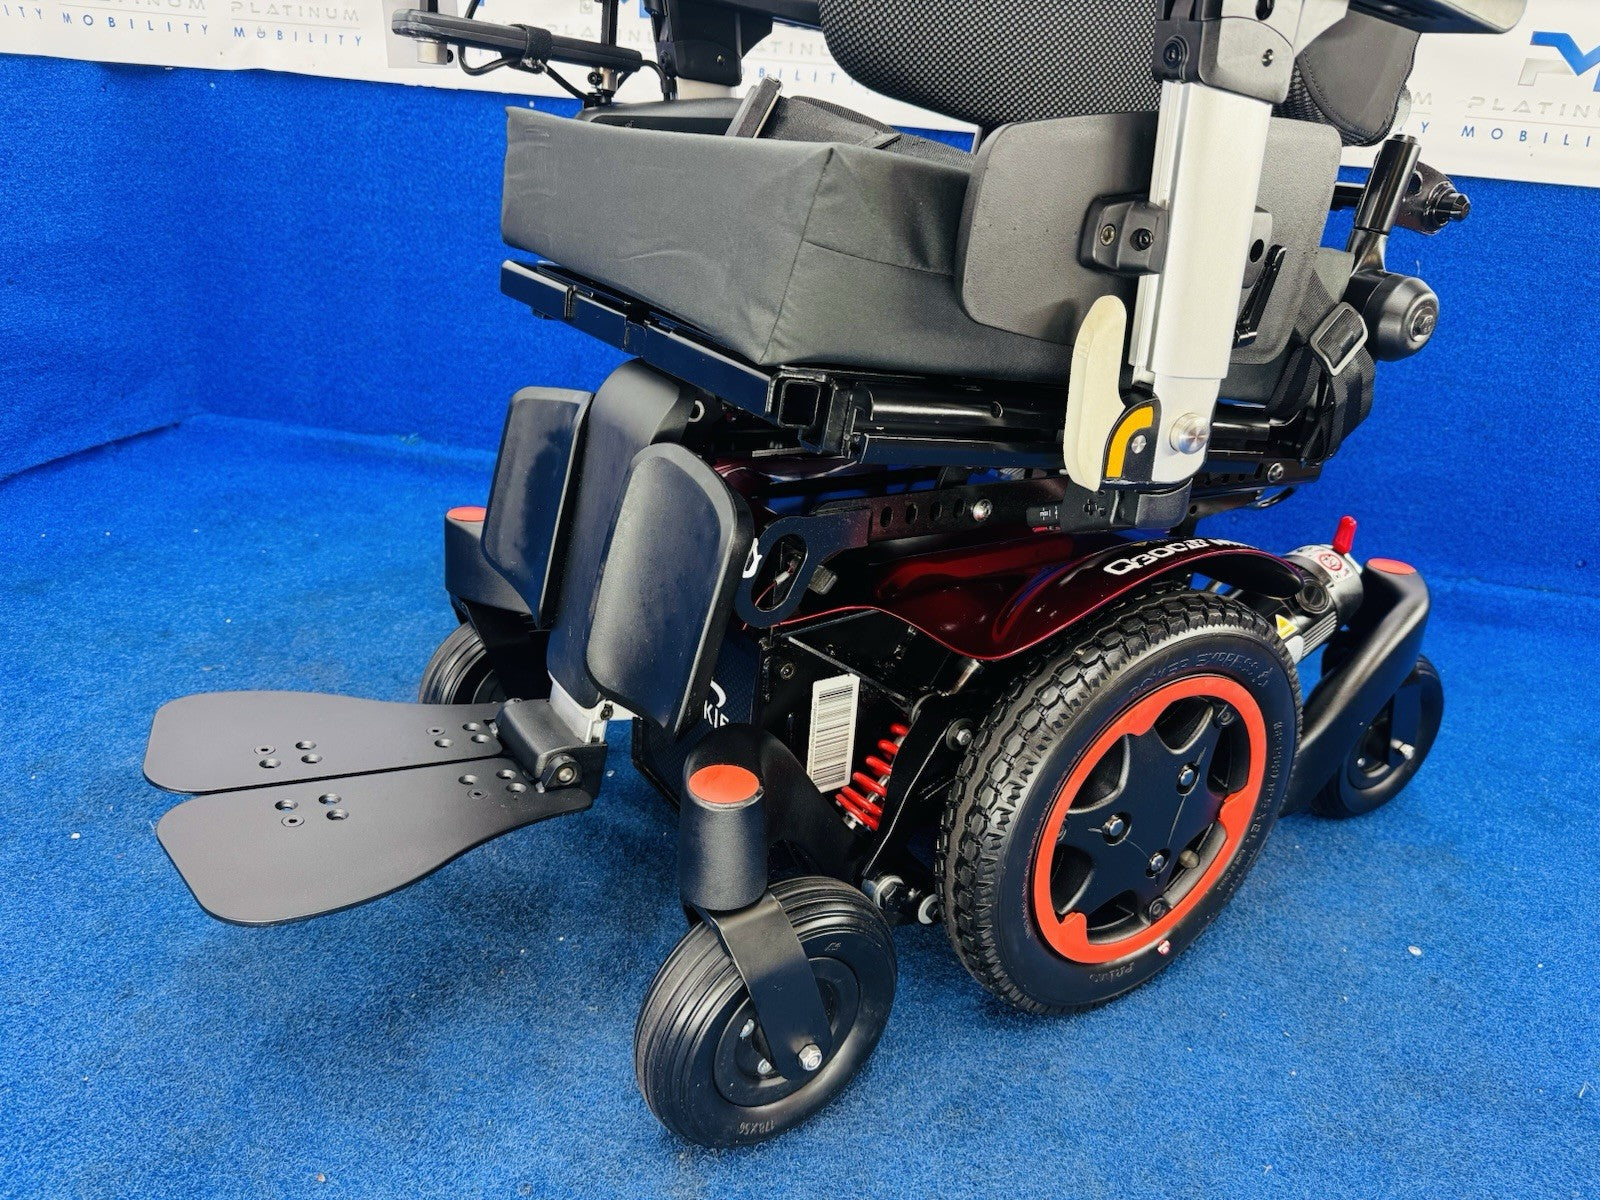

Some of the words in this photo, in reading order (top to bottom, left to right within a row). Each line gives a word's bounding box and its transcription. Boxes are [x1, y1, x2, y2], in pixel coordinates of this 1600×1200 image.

[230, 1, 359, 21] PLATINUM
[62, 12, 208, 35] MOBILITY
[1467, 96, 1600, 118] PLATIN
[1461, 125, 1591, 147] MOBILI
[1103, 542, 1188, 575] Q300
